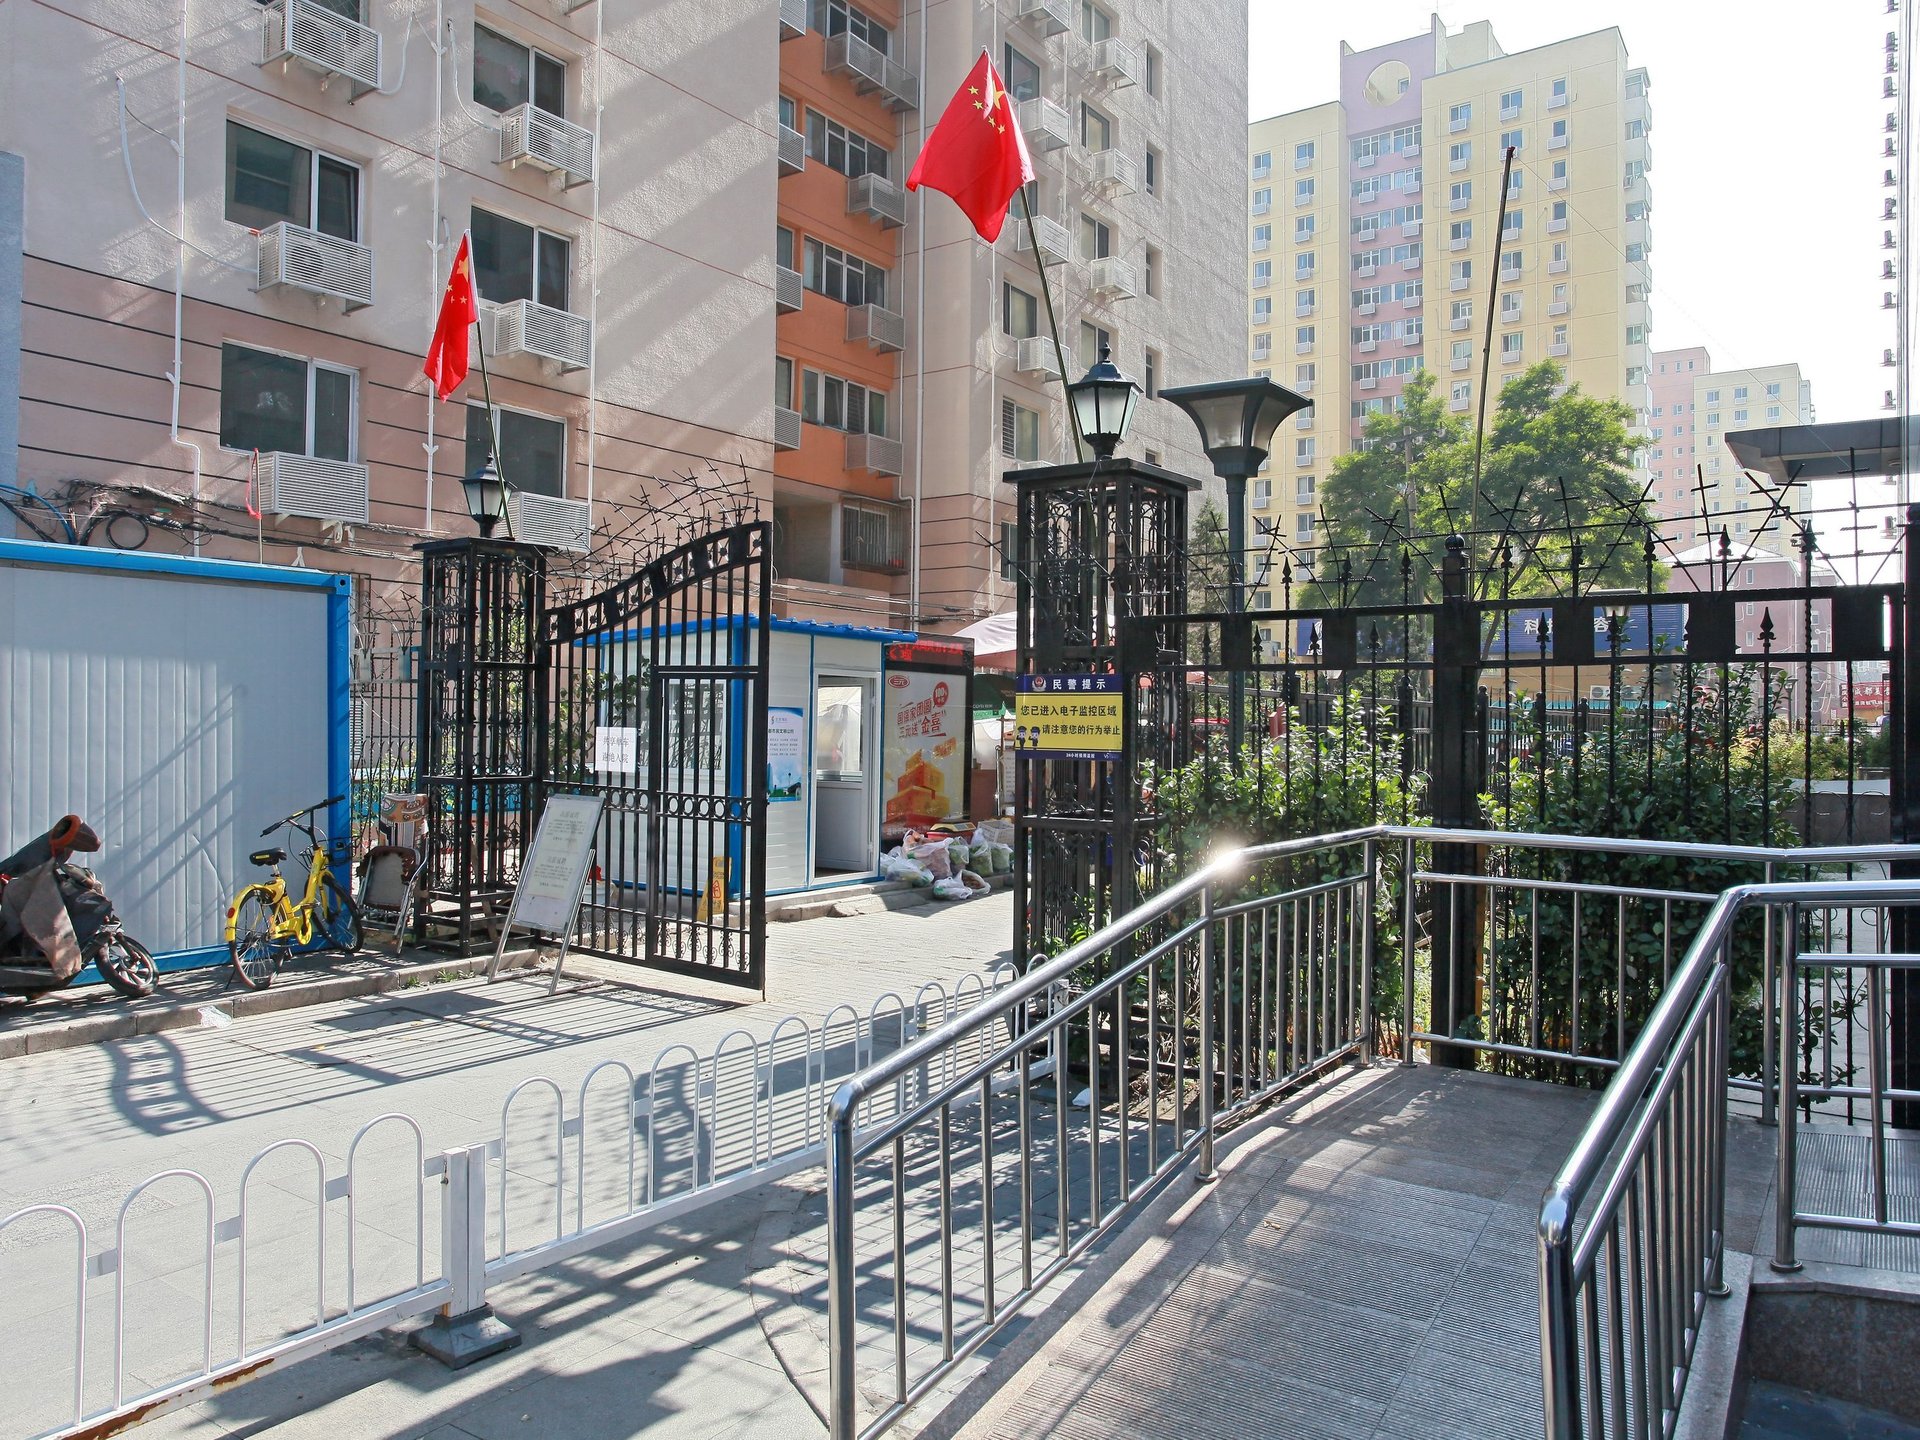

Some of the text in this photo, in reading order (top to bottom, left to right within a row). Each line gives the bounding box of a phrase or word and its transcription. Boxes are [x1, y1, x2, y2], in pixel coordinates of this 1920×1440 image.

[1052, 678, 1106, 690] 民警提示
[1020, 705, 1117, 717] 您已进入电子监控区域
[1042, 724, 1121, 736] 请注意您的行为举止
